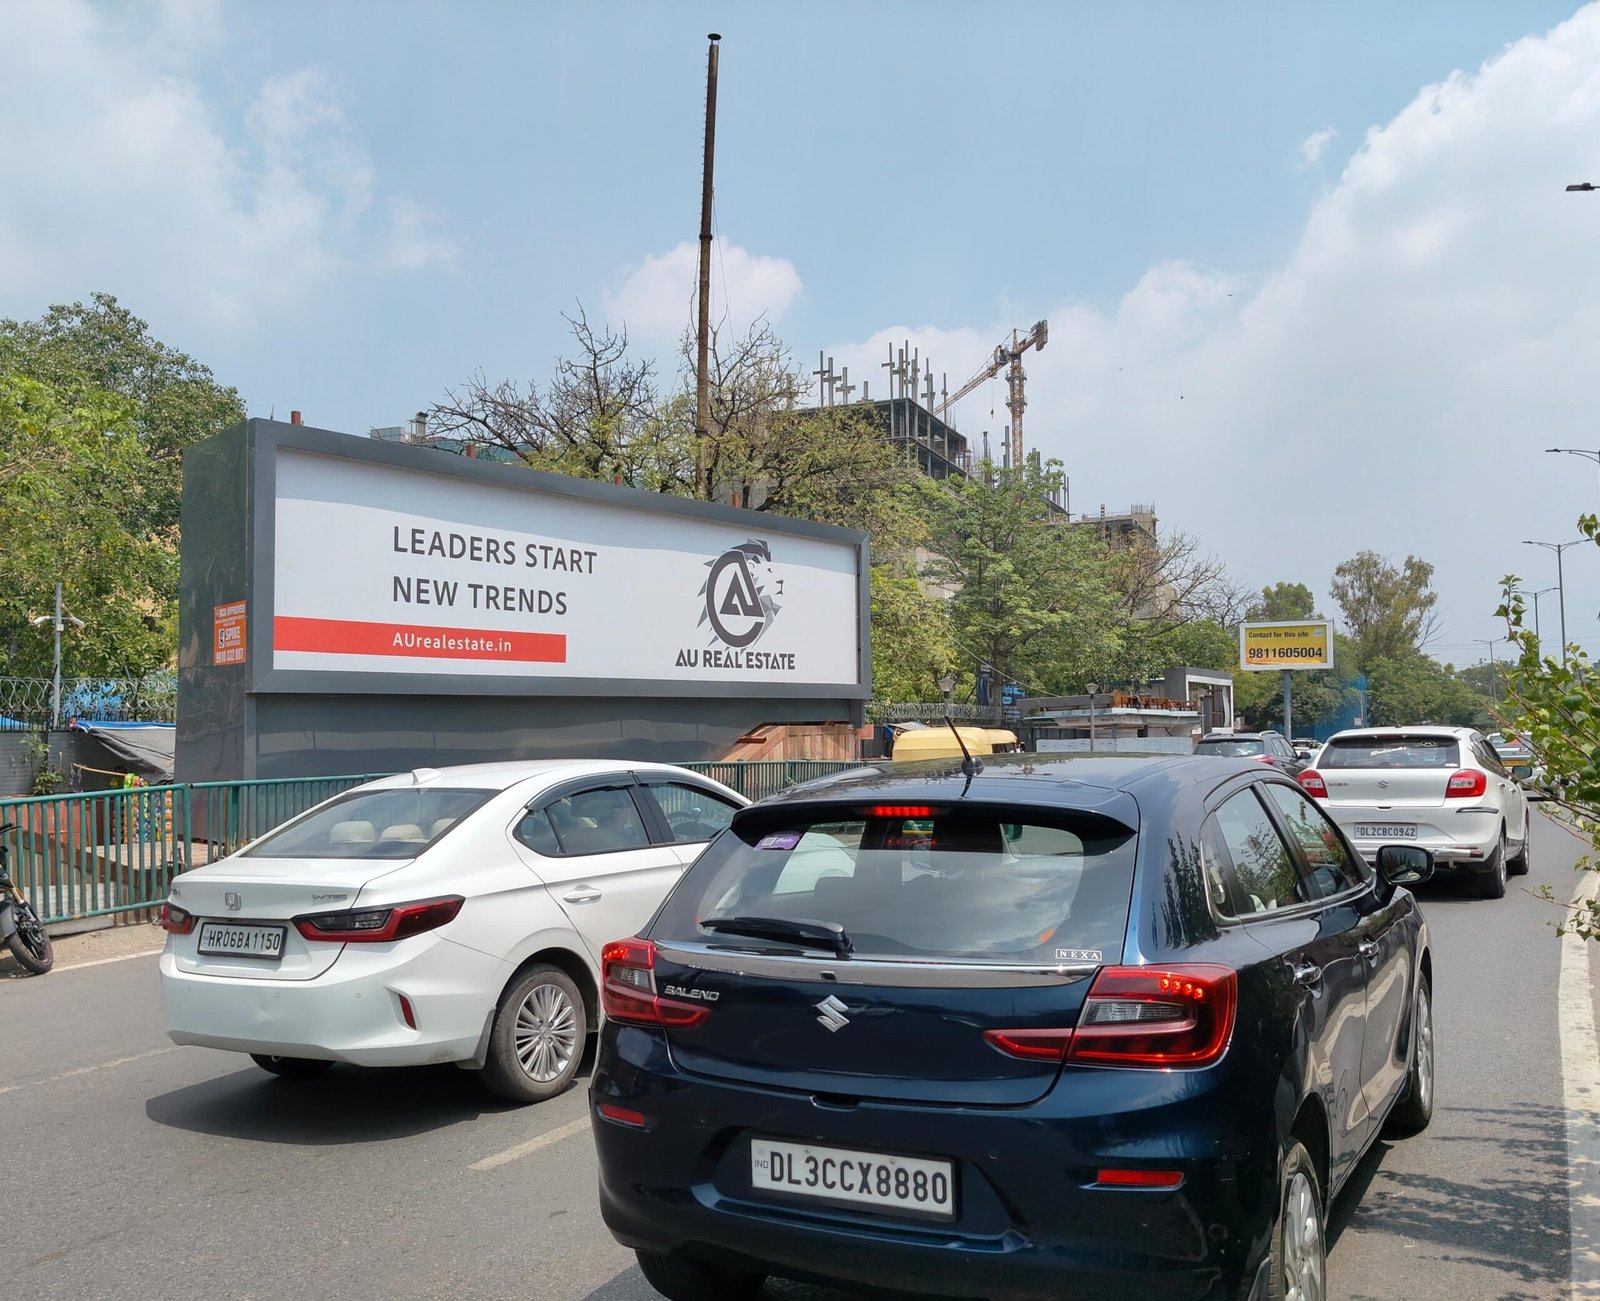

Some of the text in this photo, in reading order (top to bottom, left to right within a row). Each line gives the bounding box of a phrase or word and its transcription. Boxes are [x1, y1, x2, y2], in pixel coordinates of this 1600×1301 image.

[393, 526, 598, 574] LEADERS START
[393, 576, 568, 615] NEW TRENDS
[225, 626, 241, 640] SPIKE
[392, 632, 513, 652] AUrealestate.in
[675, 648, 796, 670] AU REAL ESTATE
[1248, 647, 1323, 658] 9811605004
[1360, 827, 1416, 837] DL2CBC0942
[207, 925, 281, 950] HR06BA1150
[1059, 949, 1099, 959] NEXA
[664, 985, 720, 1001] BALENO
[754, 1151, 948, 1204] IND DL3CCX8880
